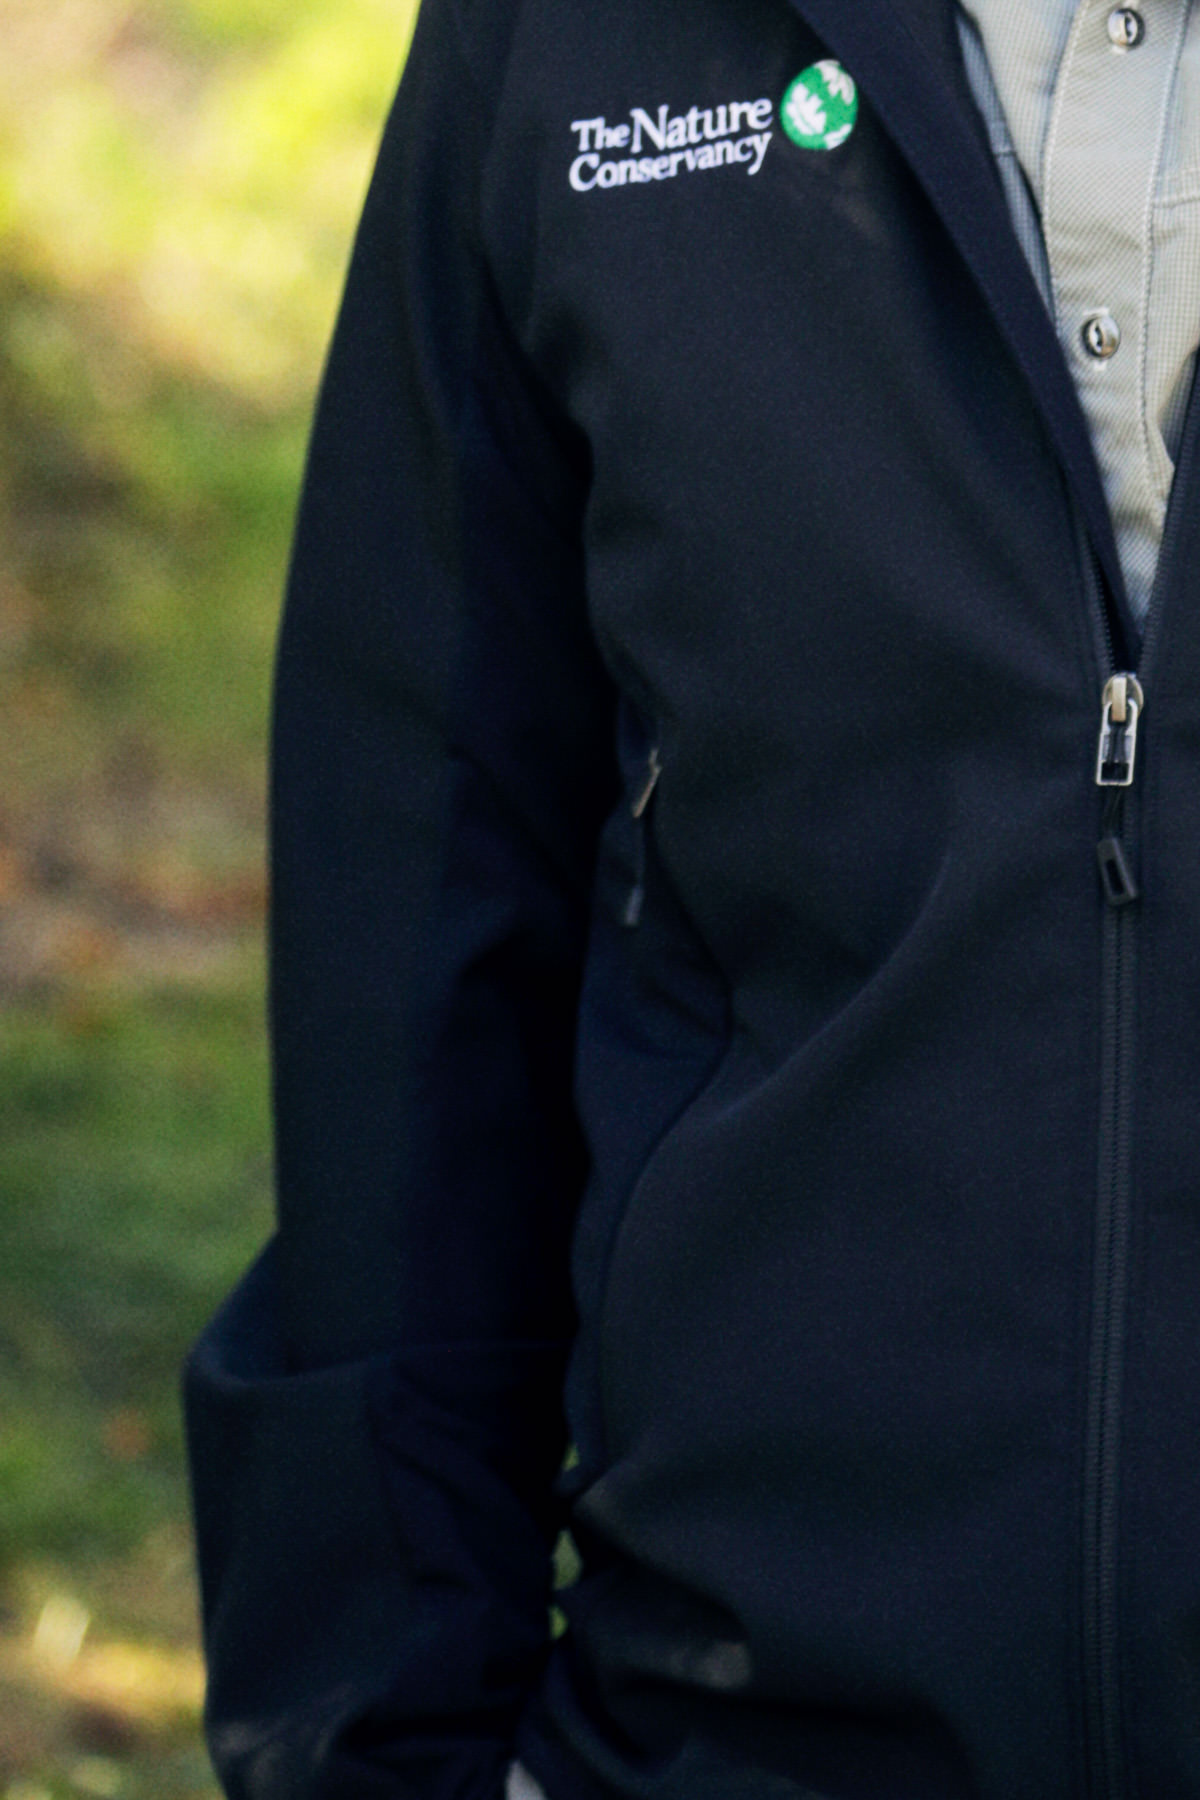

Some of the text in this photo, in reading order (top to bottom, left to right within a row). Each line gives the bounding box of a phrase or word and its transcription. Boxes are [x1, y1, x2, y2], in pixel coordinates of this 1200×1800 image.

[570, 98, 774, 154] The Nature
[569, 131, 773, 192] Conservancy
